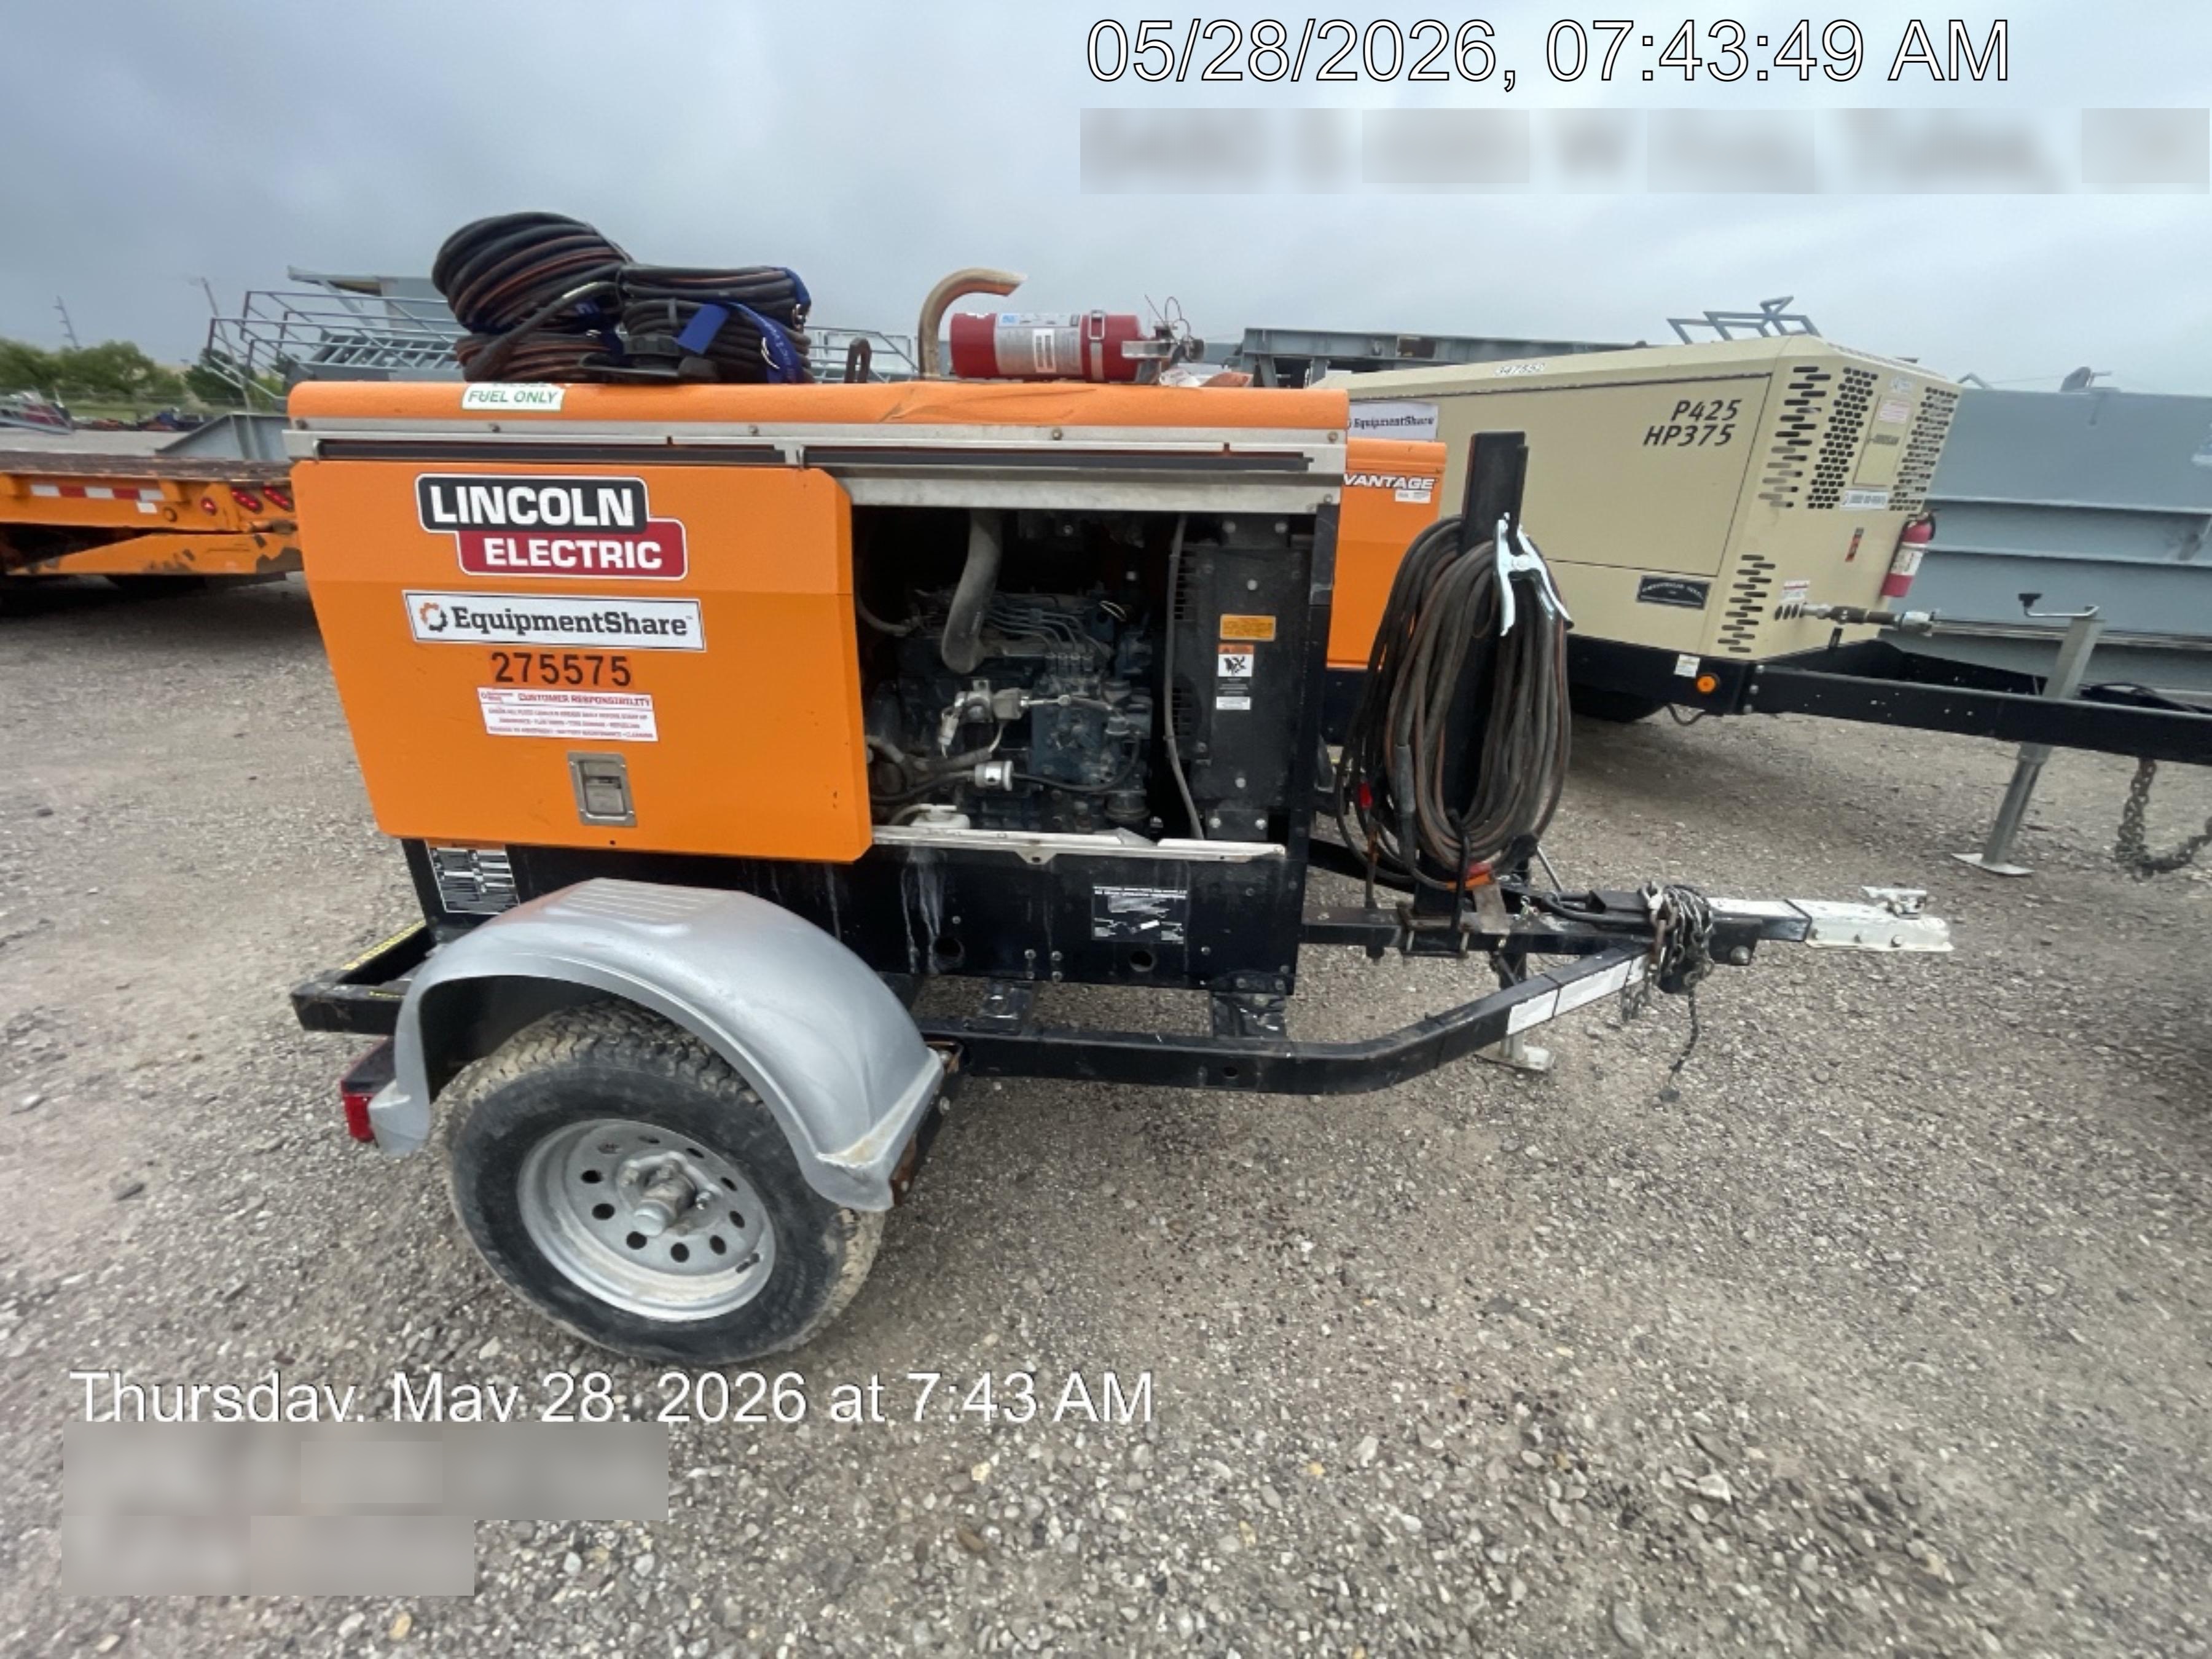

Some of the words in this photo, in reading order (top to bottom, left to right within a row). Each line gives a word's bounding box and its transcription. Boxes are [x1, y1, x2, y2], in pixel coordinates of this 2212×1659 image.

[468, 390, 509, 403] FUEL
[514, 390, 559, 404] ONLY
[1354, 415, 1435, 429] EquipmentShare
[1670, 399, 1743, 422] P425
[1642, 423, 1736, 447] HP375
[1343, 473, 1435, 490] VANTAGE
[429, 485, 635, 527] LINCOLN
[483, 537, 663, 570] ELECTRIC
[450, 606, 688, 637] EquipmentShare
[491, 651, 632, 687] 275575
[517, 692, 569, 703] CUSTOMER
[571, 694, 650, 707] RESPONSIBILITY
